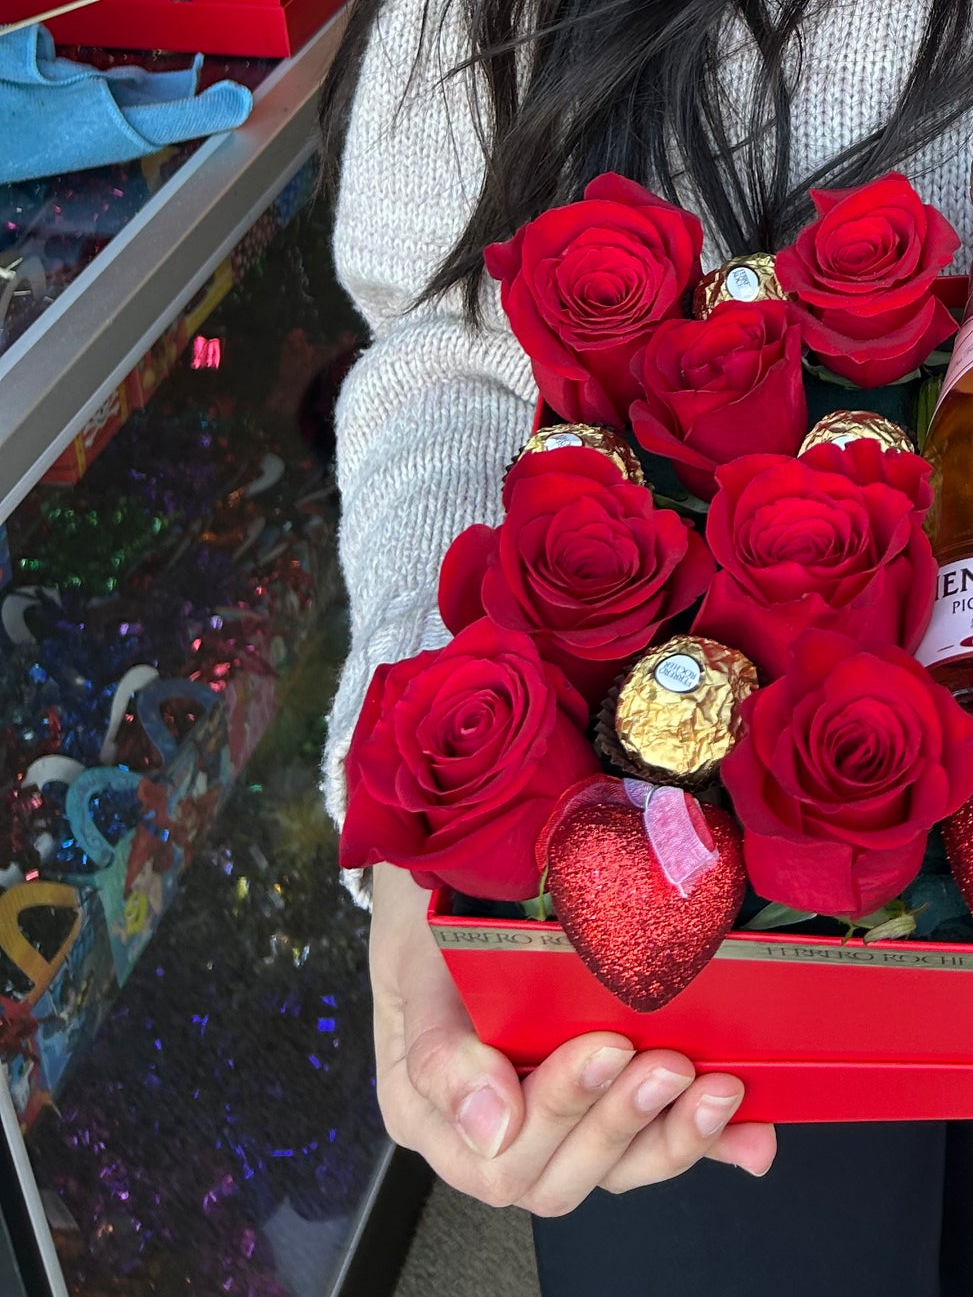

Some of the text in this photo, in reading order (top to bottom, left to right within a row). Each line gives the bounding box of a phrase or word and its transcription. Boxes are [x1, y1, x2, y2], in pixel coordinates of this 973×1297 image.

[658, 667, 692, 687] FERRERO
[663, 661, 697, 680] ROCHER
[439, 931, 533, 945] ERRERO
[766, 946, 875, 962] FERRERO
